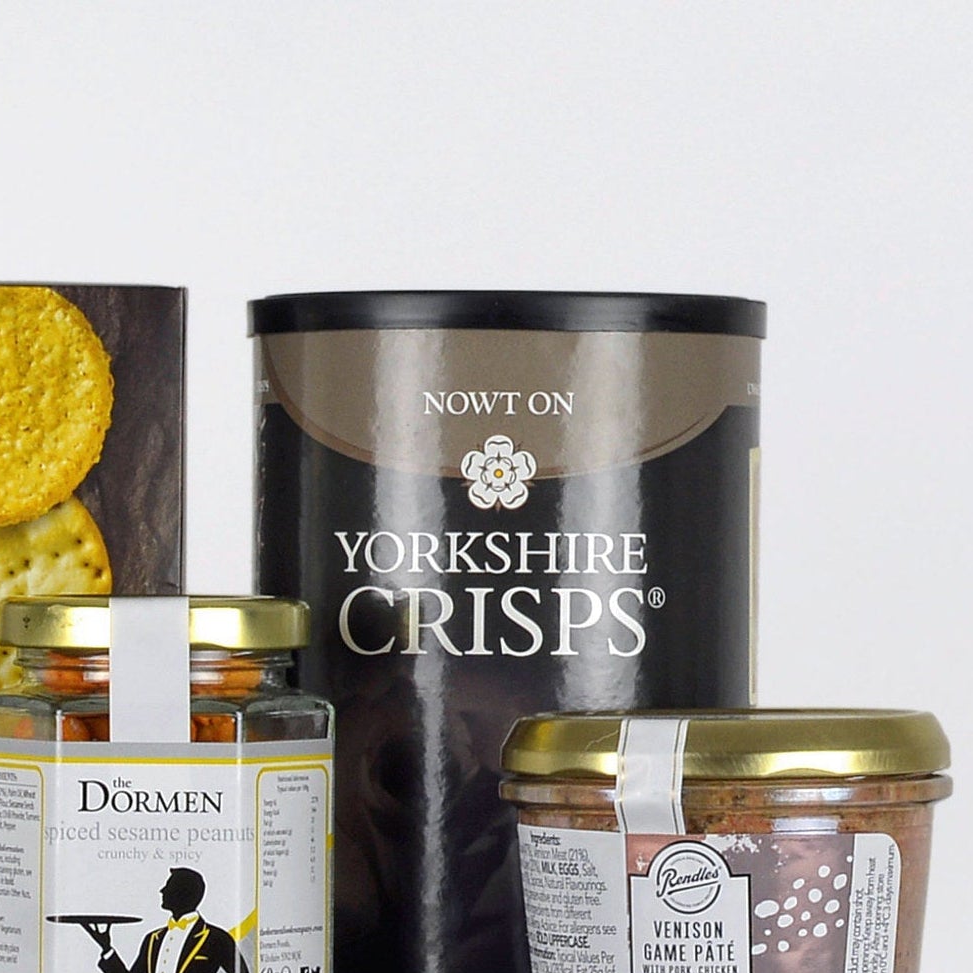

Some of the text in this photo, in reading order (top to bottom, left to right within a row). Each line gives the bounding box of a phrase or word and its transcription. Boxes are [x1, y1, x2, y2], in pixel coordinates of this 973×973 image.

[423, 391, 574, 415] NOWT ON
[334, 531, 648, 574] YORKSHIRE
[113, 777, 132, 788] the
[44, 821, 254, 845] spiced sesame peanuts
[98, 848, 202, 864] crunchy & spicy
[653, 921, 723, 939] VENISON
[643, 940, 735, 962] GAME PÂTÉ
